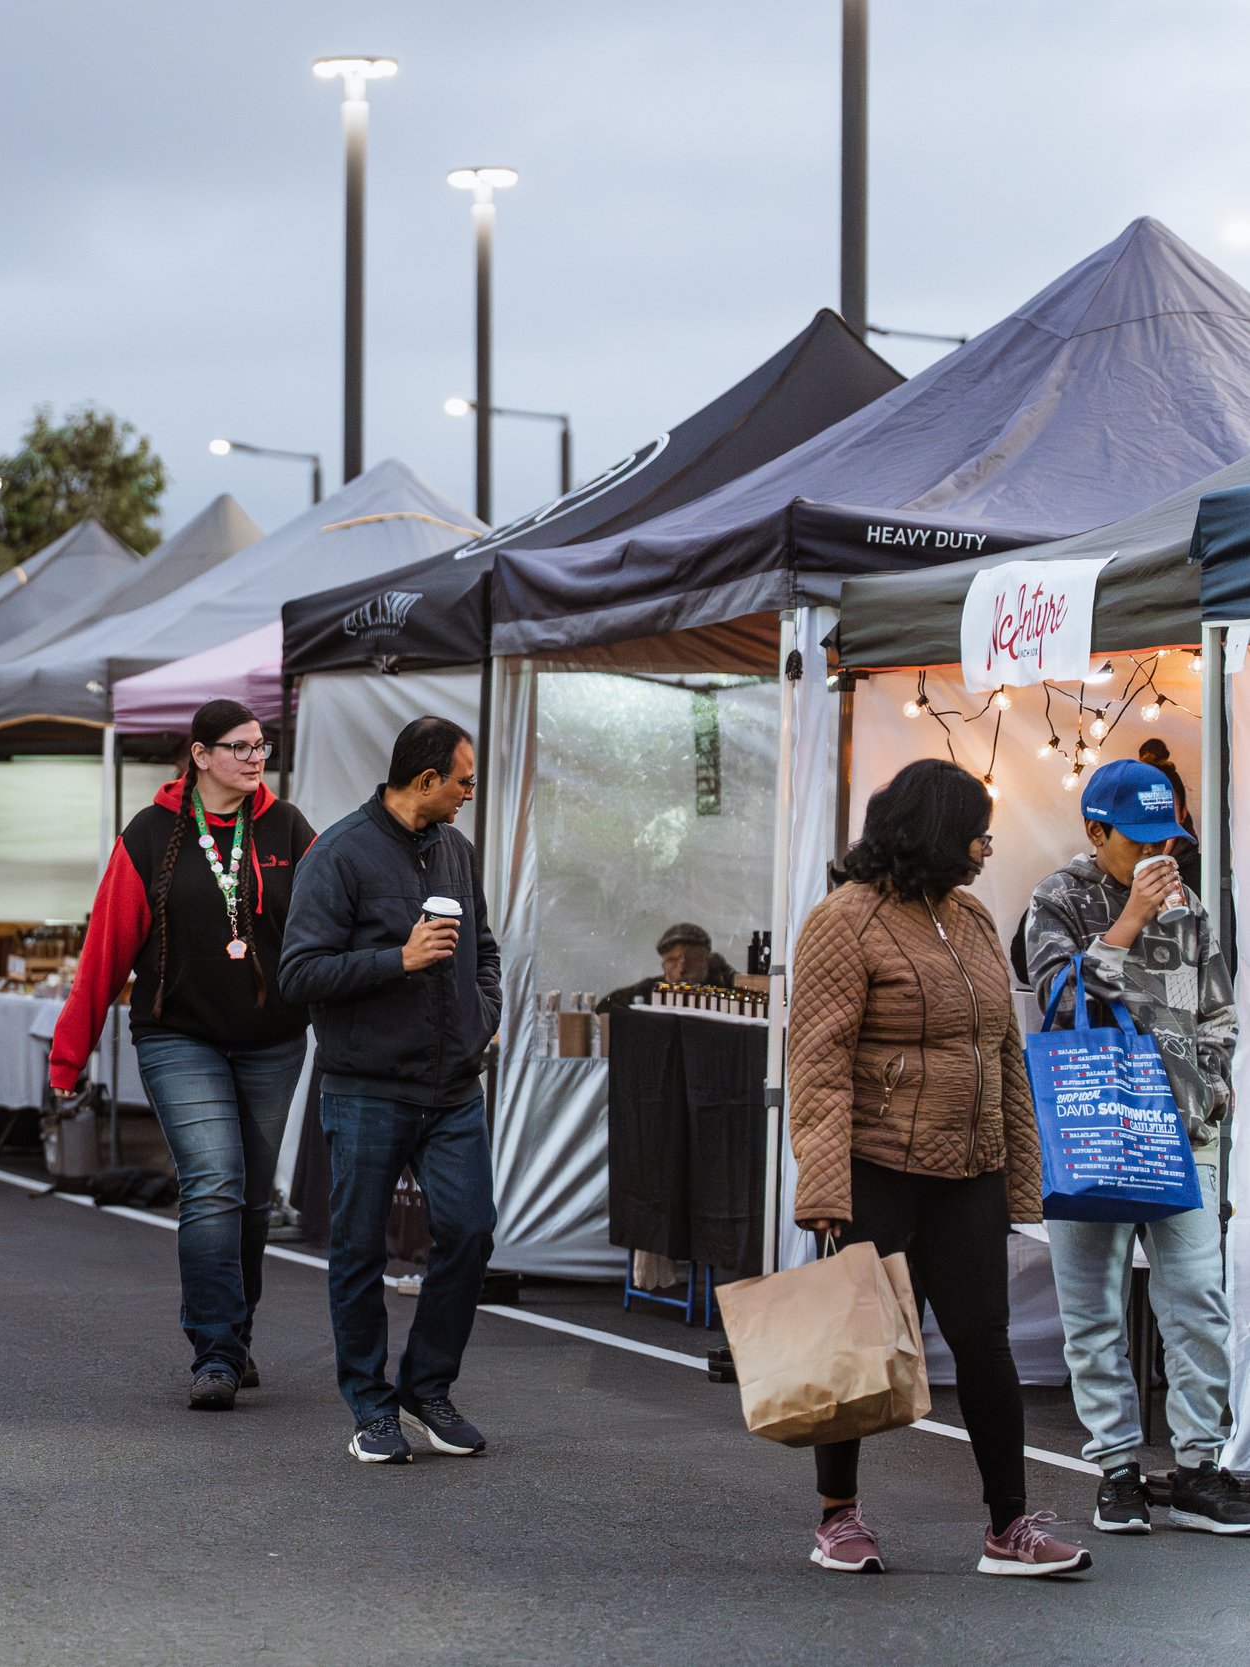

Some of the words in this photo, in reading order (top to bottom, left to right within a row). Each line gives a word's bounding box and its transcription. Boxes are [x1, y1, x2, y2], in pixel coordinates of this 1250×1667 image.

[867, 526, 931, 546] HEAVY
[935, 531, 987, 550] DUTY
[1056, 1093, 1079, 1104] SHOP
[1078, 1090, 1101, 1101] LOCAL
[1056, 1104, 1095, 1117] DAVID
[1098, 1102, 1162, 1122] SOUTHWICK
[1164, 1113, 1176, 1123] MP
[1130, 1120, 1176, 1134] CAULFIELD
